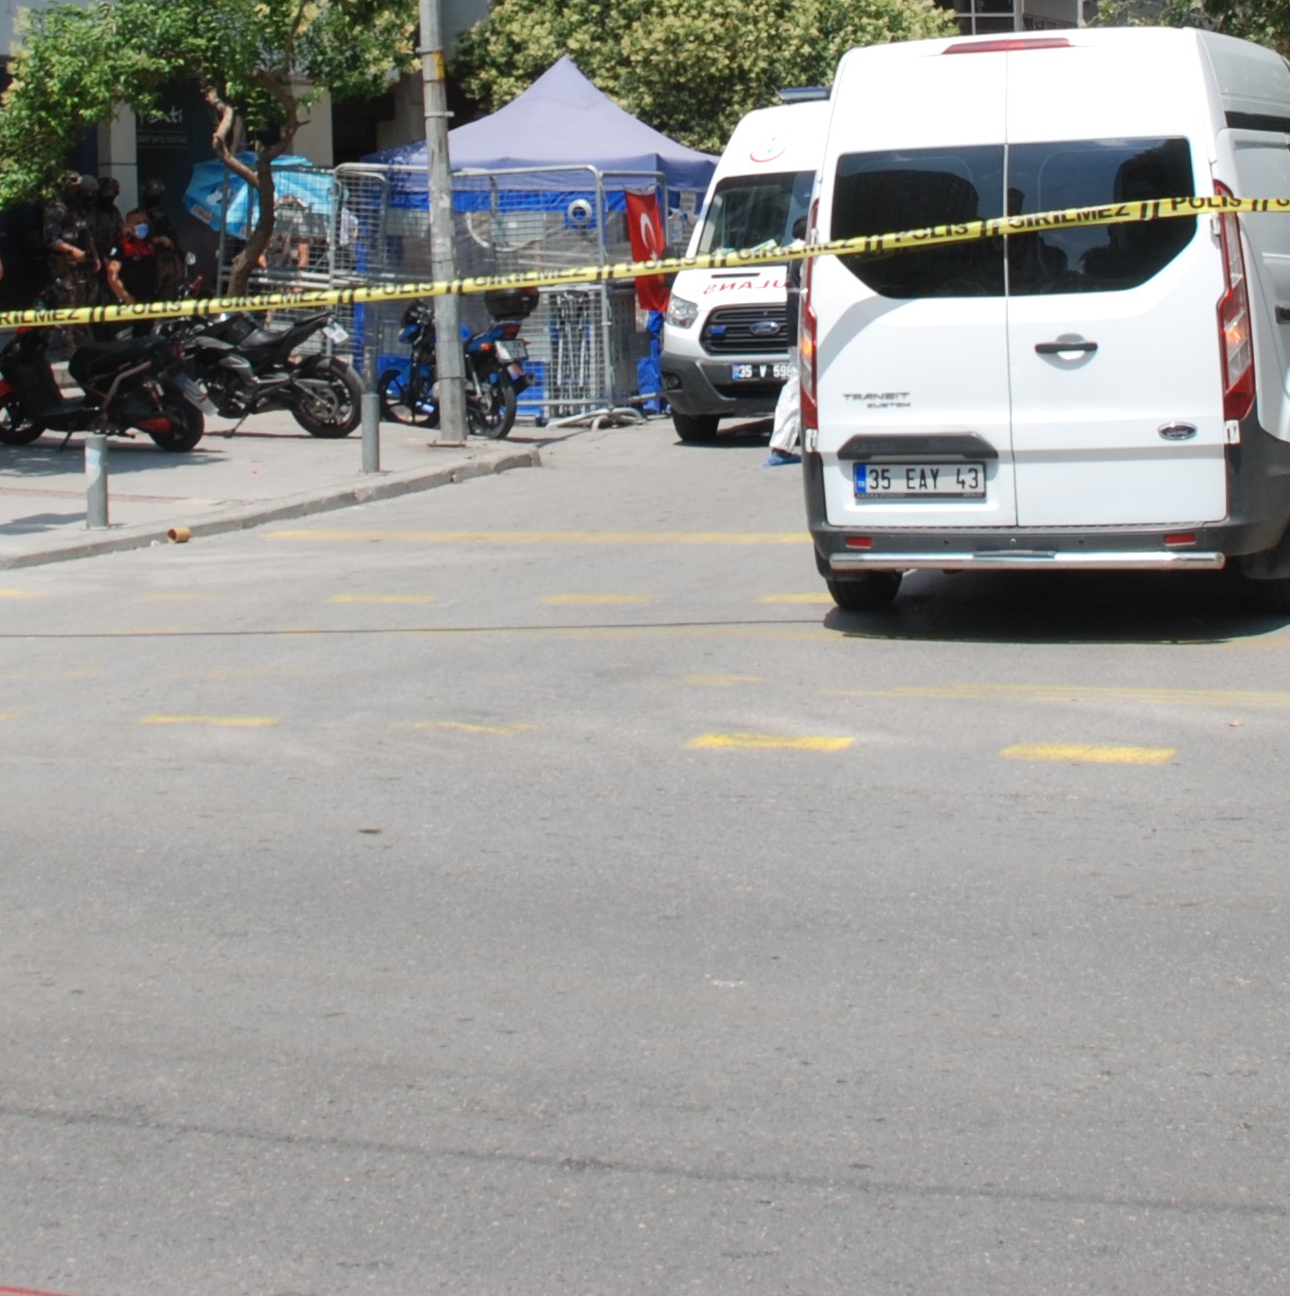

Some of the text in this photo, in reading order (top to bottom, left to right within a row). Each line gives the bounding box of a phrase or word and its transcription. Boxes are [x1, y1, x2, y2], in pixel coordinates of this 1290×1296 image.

[842, 391, 911, 401] TRANSIT
[868, 468, 892, 491] 35
[905, 468, 940, 490] EAY
[956, 468, 979, 489] 43
